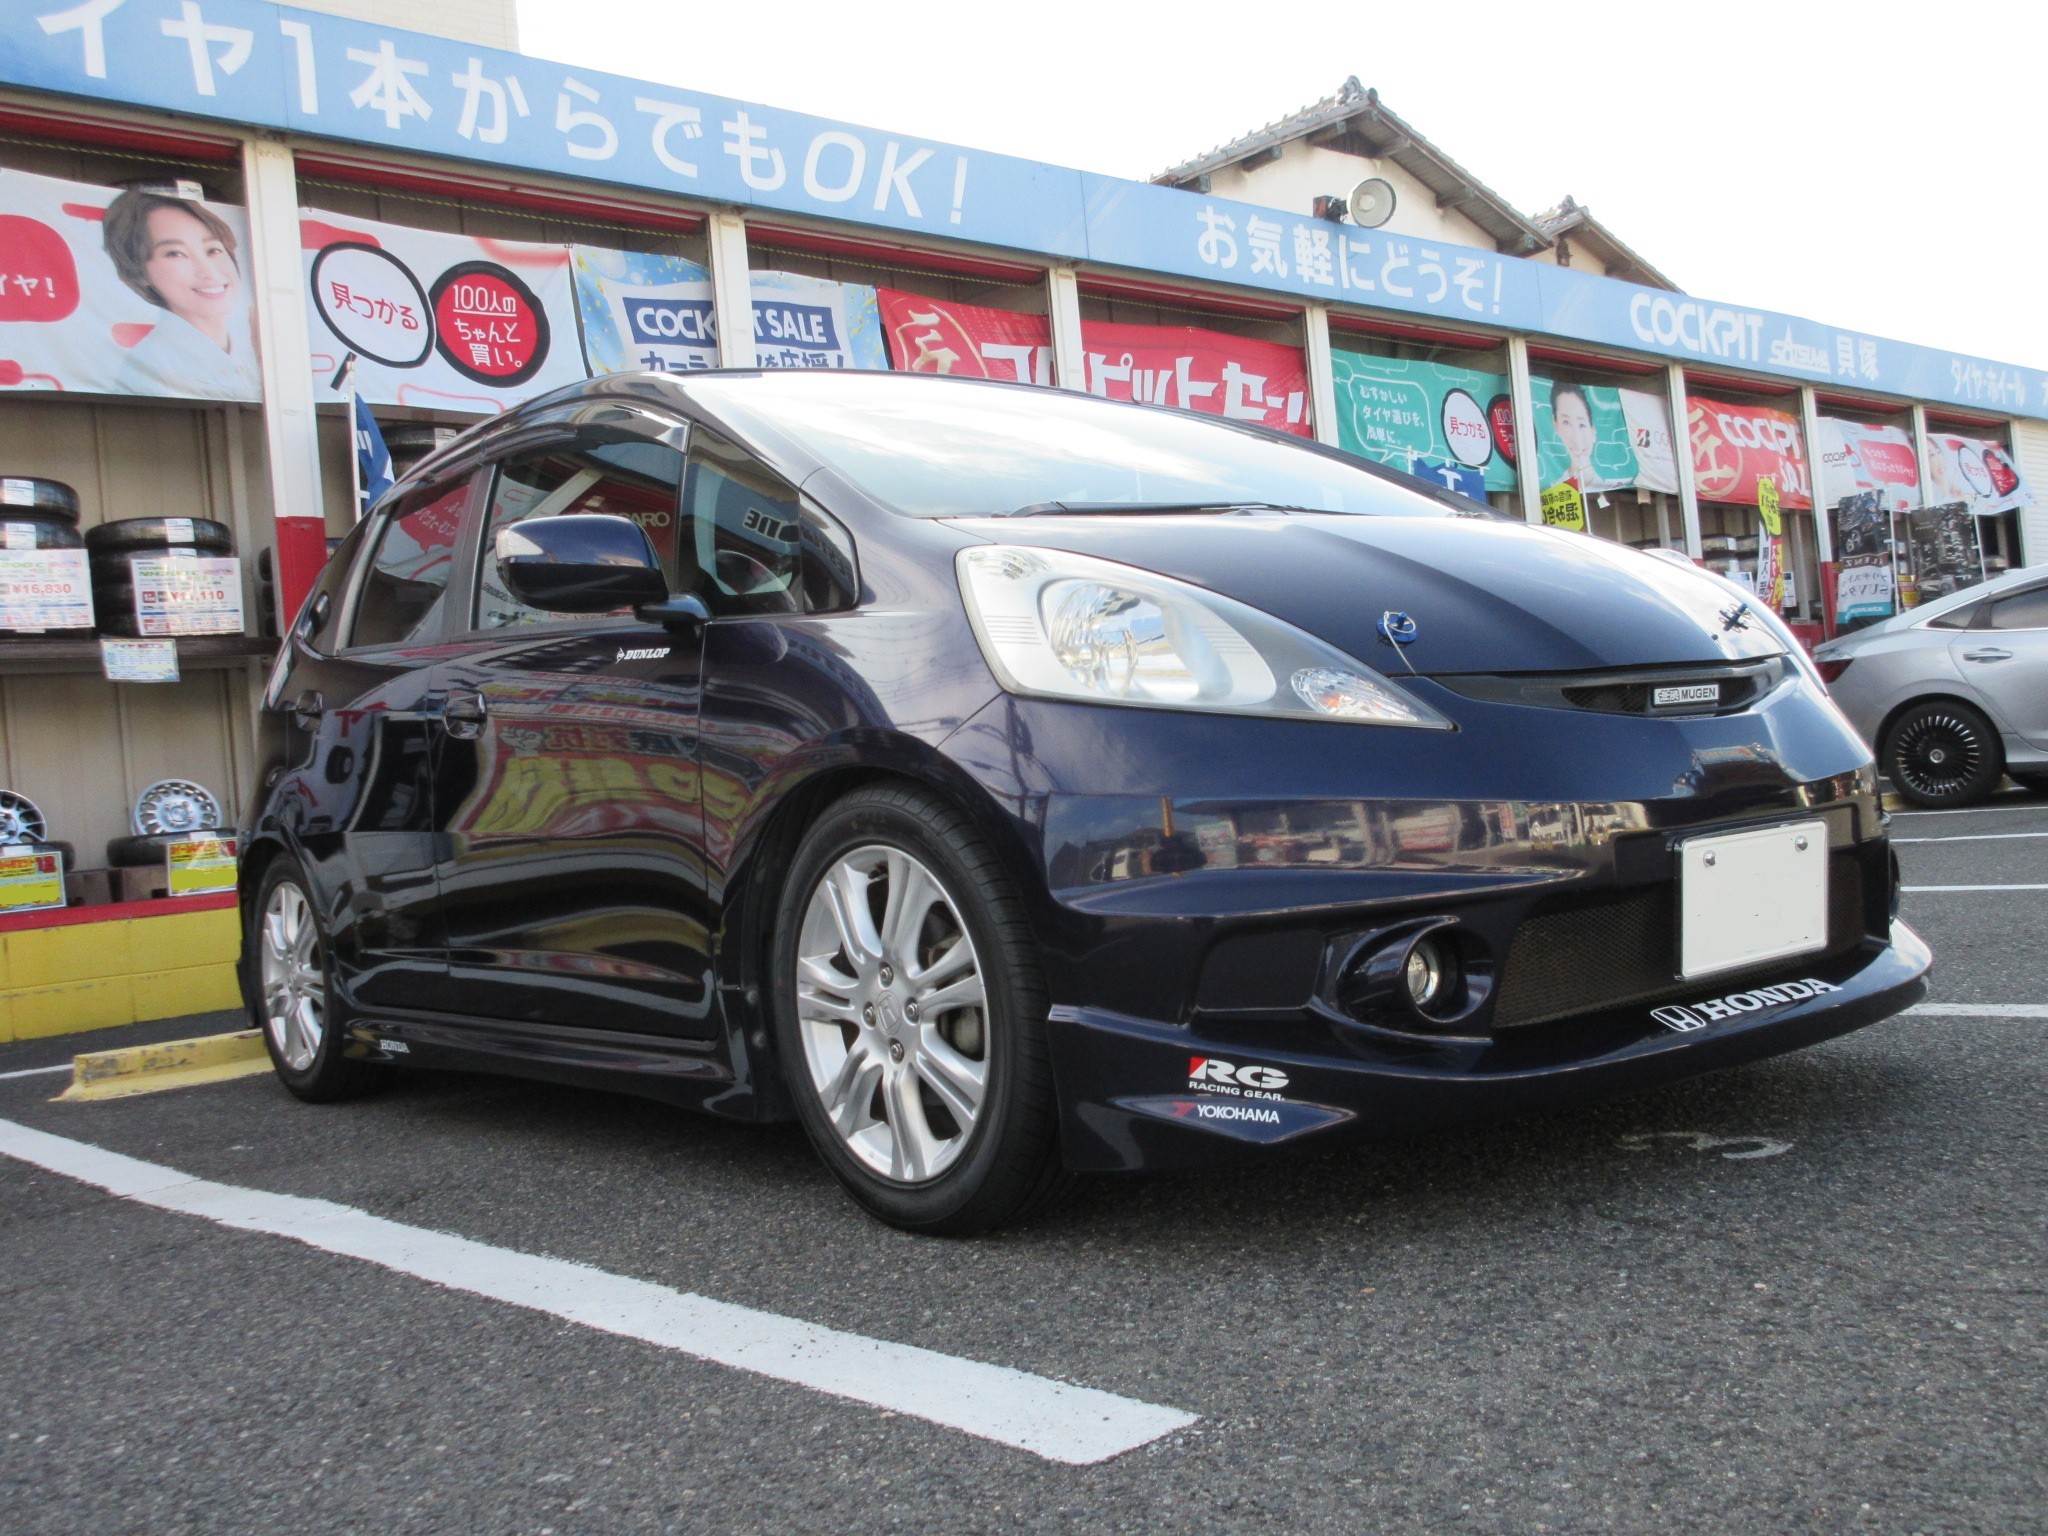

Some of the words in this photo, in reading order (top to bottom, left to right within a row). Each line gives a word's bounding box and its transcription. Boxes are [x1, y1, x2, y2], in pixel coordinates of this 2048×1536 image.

[1196, 205, 1502, 314] お気軽にどうぞ!
[330, 281, 419, 331] 見つかる
[453, 285, 517, 313] 100人の
[455, 318, 521, 343] ちゃんと
[766, 309, 828, 344] SALE
[1629, 293, 1764, 362] COCKPIT
[1449, 416, 1486, 439] 見つかる
[624, 647, 671, 661] DUNLOP
[1681, 688, 1716, 700] MUGEN
[1692, 978, 1843, 1020] HONDA
[1189, 1057, 1290, 1089] RG
[1189, 1081, 1240, 1096] RACING
[1197, 1104, 1281, 1124] YOKOHAMA
